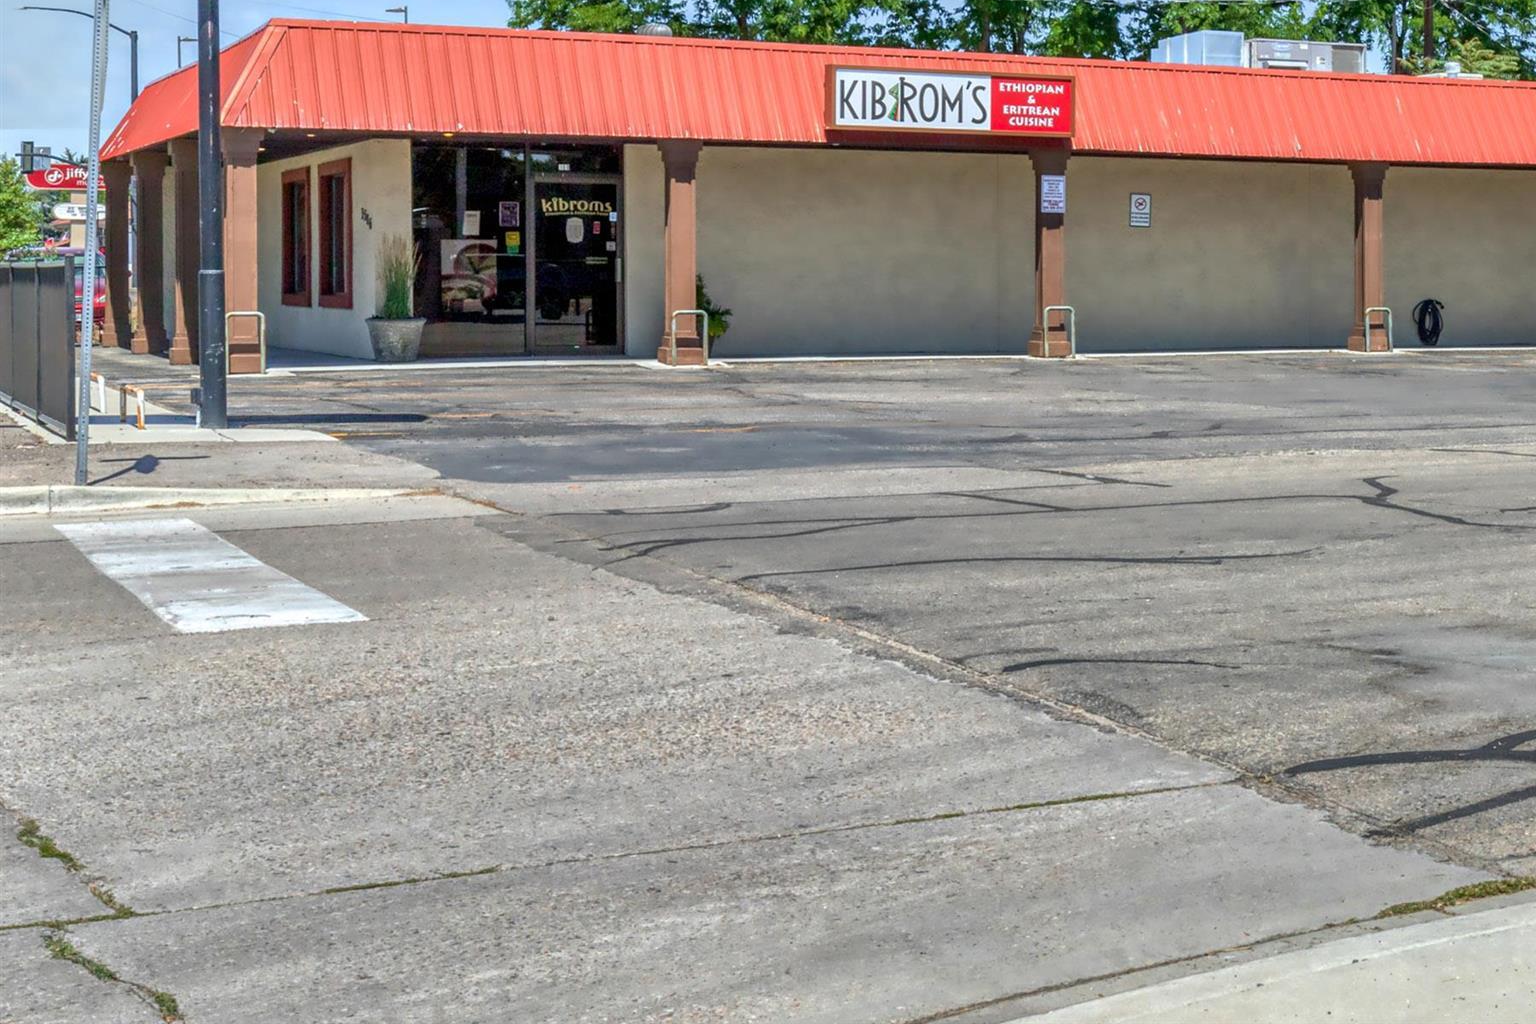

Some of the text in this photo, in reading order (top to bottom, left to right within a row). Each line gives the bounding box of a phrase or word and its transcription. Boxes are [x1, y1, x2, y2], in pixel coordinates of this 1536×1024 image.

[999, 82, 1064, 95] ETHIOPIAN
[1027, 95, 1036, 104] &
[1003, 105, 1060, 116] ERITREAN
[1008, 117, 1054, 127] CUISINE
